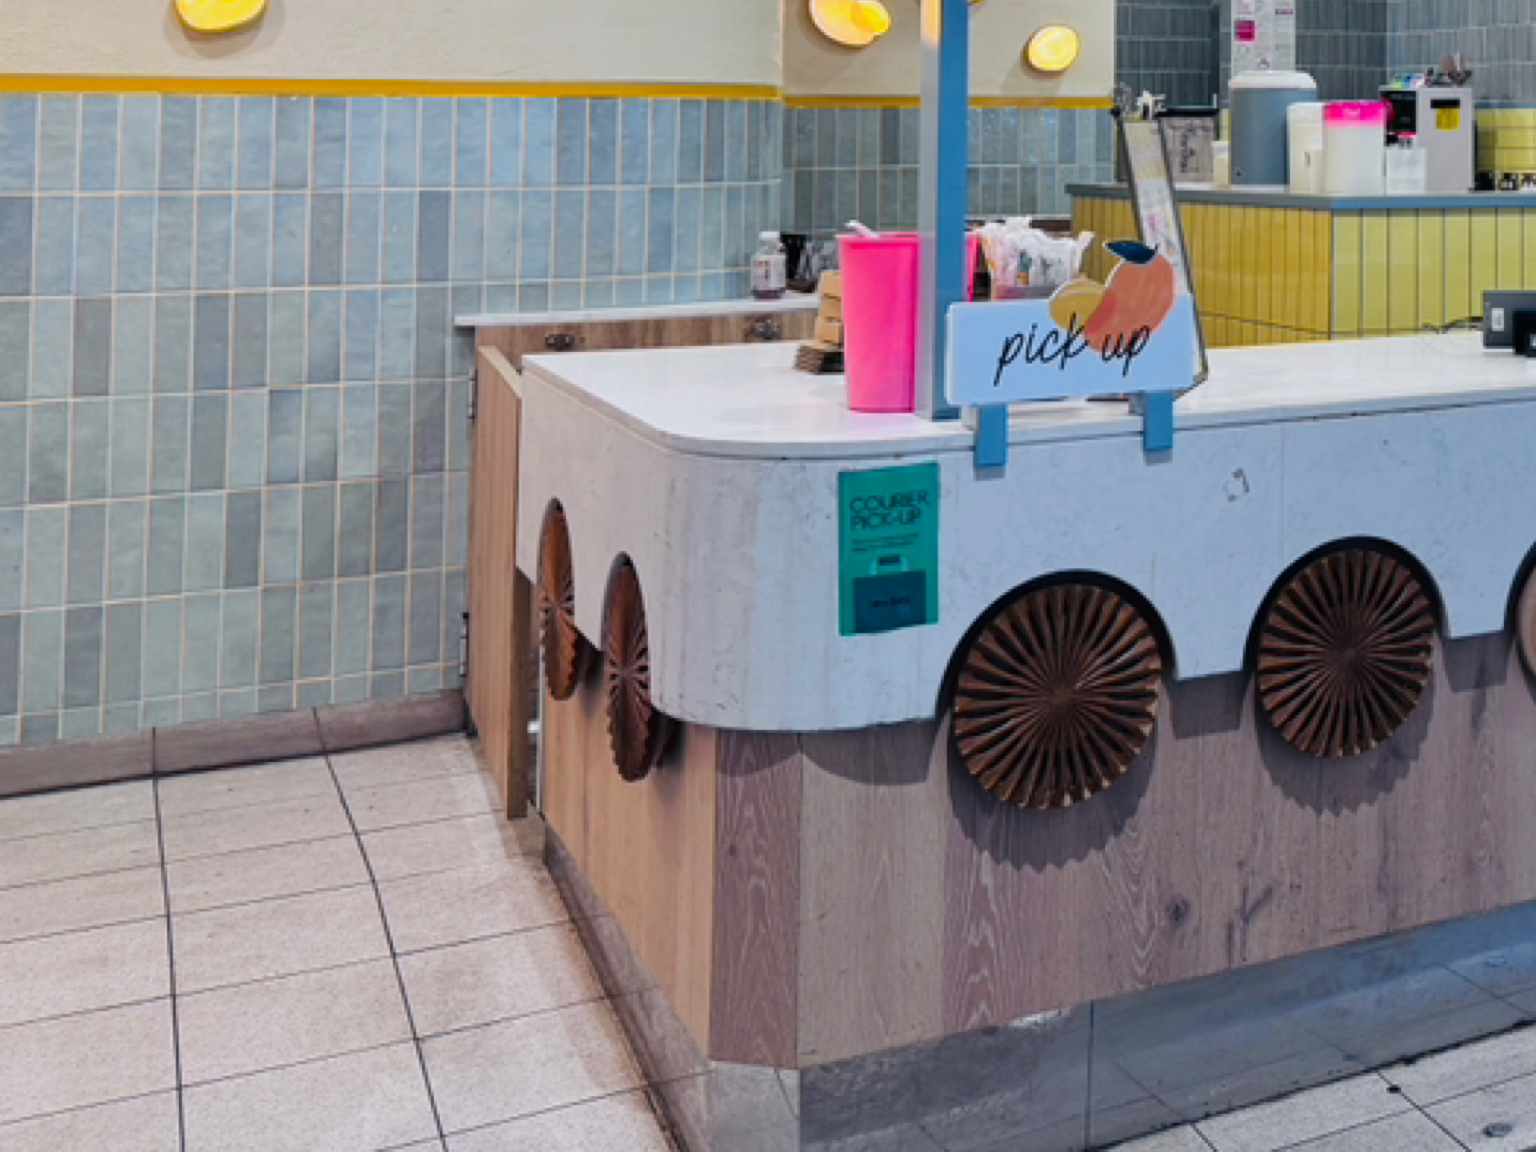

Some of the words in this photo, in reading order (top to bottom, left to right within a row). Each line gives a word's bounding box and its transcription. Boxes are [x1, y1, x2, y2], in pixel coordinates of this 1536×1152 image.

[993, 312, 1090, 387] pick
[1101, 325, 1151, 378] up
[850, 489, 930, 512] COURIER
[850, 507, 921, 530] PICK-UP
